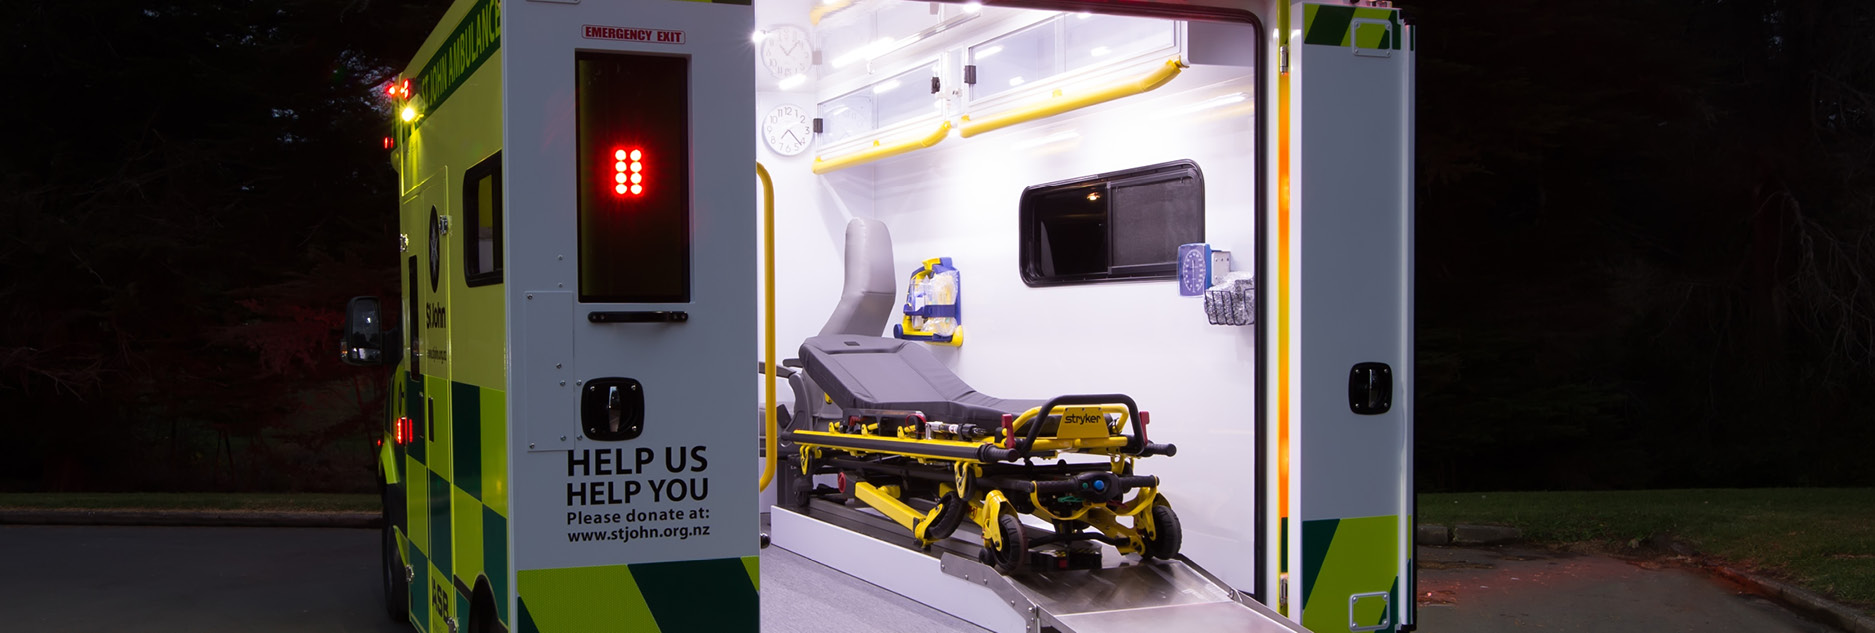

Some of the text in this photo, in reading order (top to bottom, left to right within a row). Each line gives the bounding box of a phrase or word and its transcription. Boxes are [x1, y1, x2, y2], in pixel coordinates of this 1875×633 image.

[585, 25, 682, 43] EMERGENCY EXIT
[430, 52, 447, 105] JOHN
[448, 0, 500, 86] AMBULANCE
[777, 108, 783, 117] 11
[784, 106, 792, 116] 12
[769, 115, 778, 124] 10
[799, 115, 806, 124] 2
[805, 126, 811, 135] 3
[1064, 413, 1100, 425] stryker
[567, 445, 708, 477] HELP US
[567, 477, 709, 506] HELP YOU
[567, 507, 710, 525] Please donate at:
[568, 525, 710, 543] www.stjohn.org.nz
